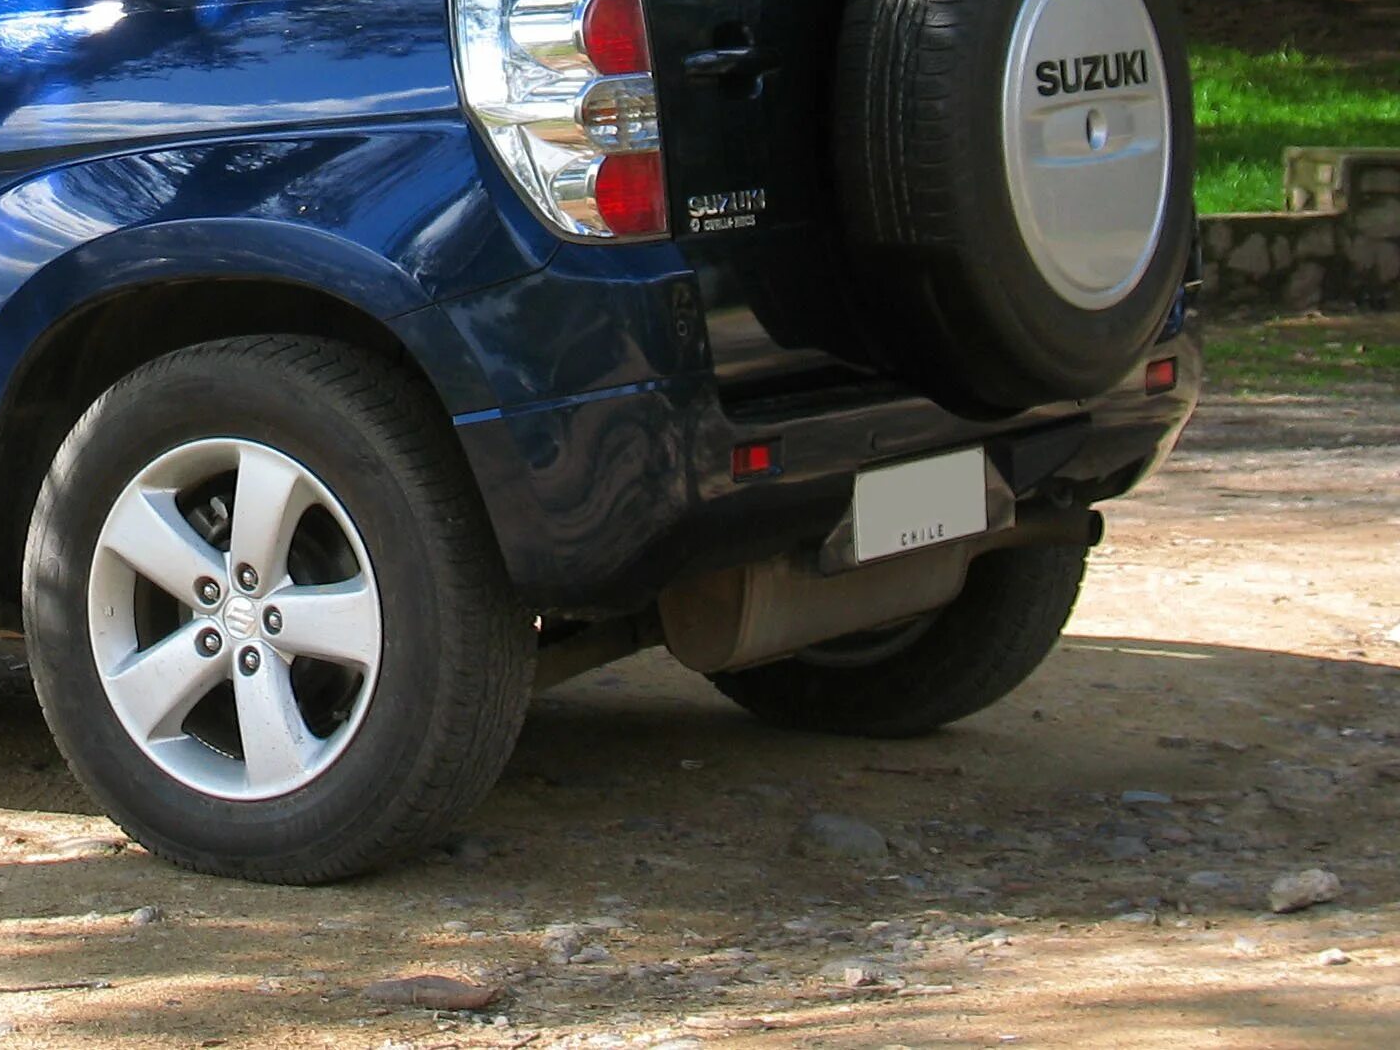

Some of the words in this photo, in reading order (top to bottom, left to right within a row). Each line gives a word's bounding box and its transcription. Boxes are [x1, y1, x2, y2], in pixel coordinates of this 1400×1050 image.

[1036, 50, 1149, 96] SUZUKI
[688, 188, 766, 217] SUZUKI
[901, 524, 944, 546] CHILE
